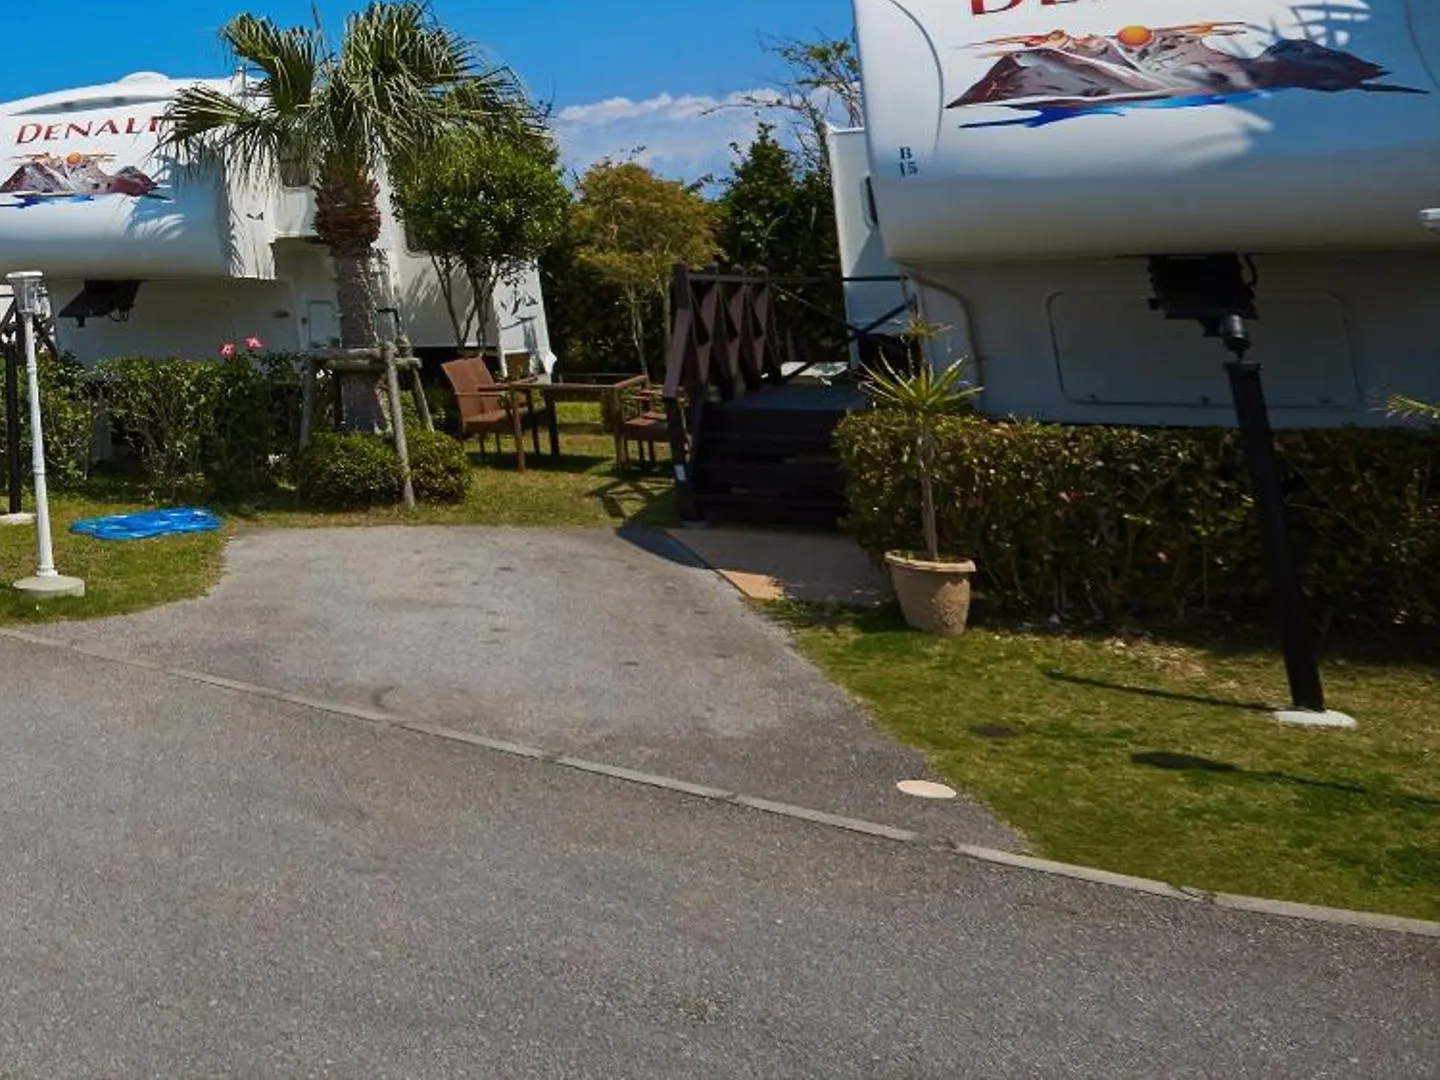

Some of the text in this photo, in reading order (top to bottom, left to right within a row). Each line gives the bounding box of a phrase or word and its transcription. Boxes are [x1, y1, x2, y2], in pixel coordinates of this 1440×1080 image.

[16, 115, 159, 144] DENALI
[900, 146, 912, 160] B
[900, 161, 919, 177] 15
